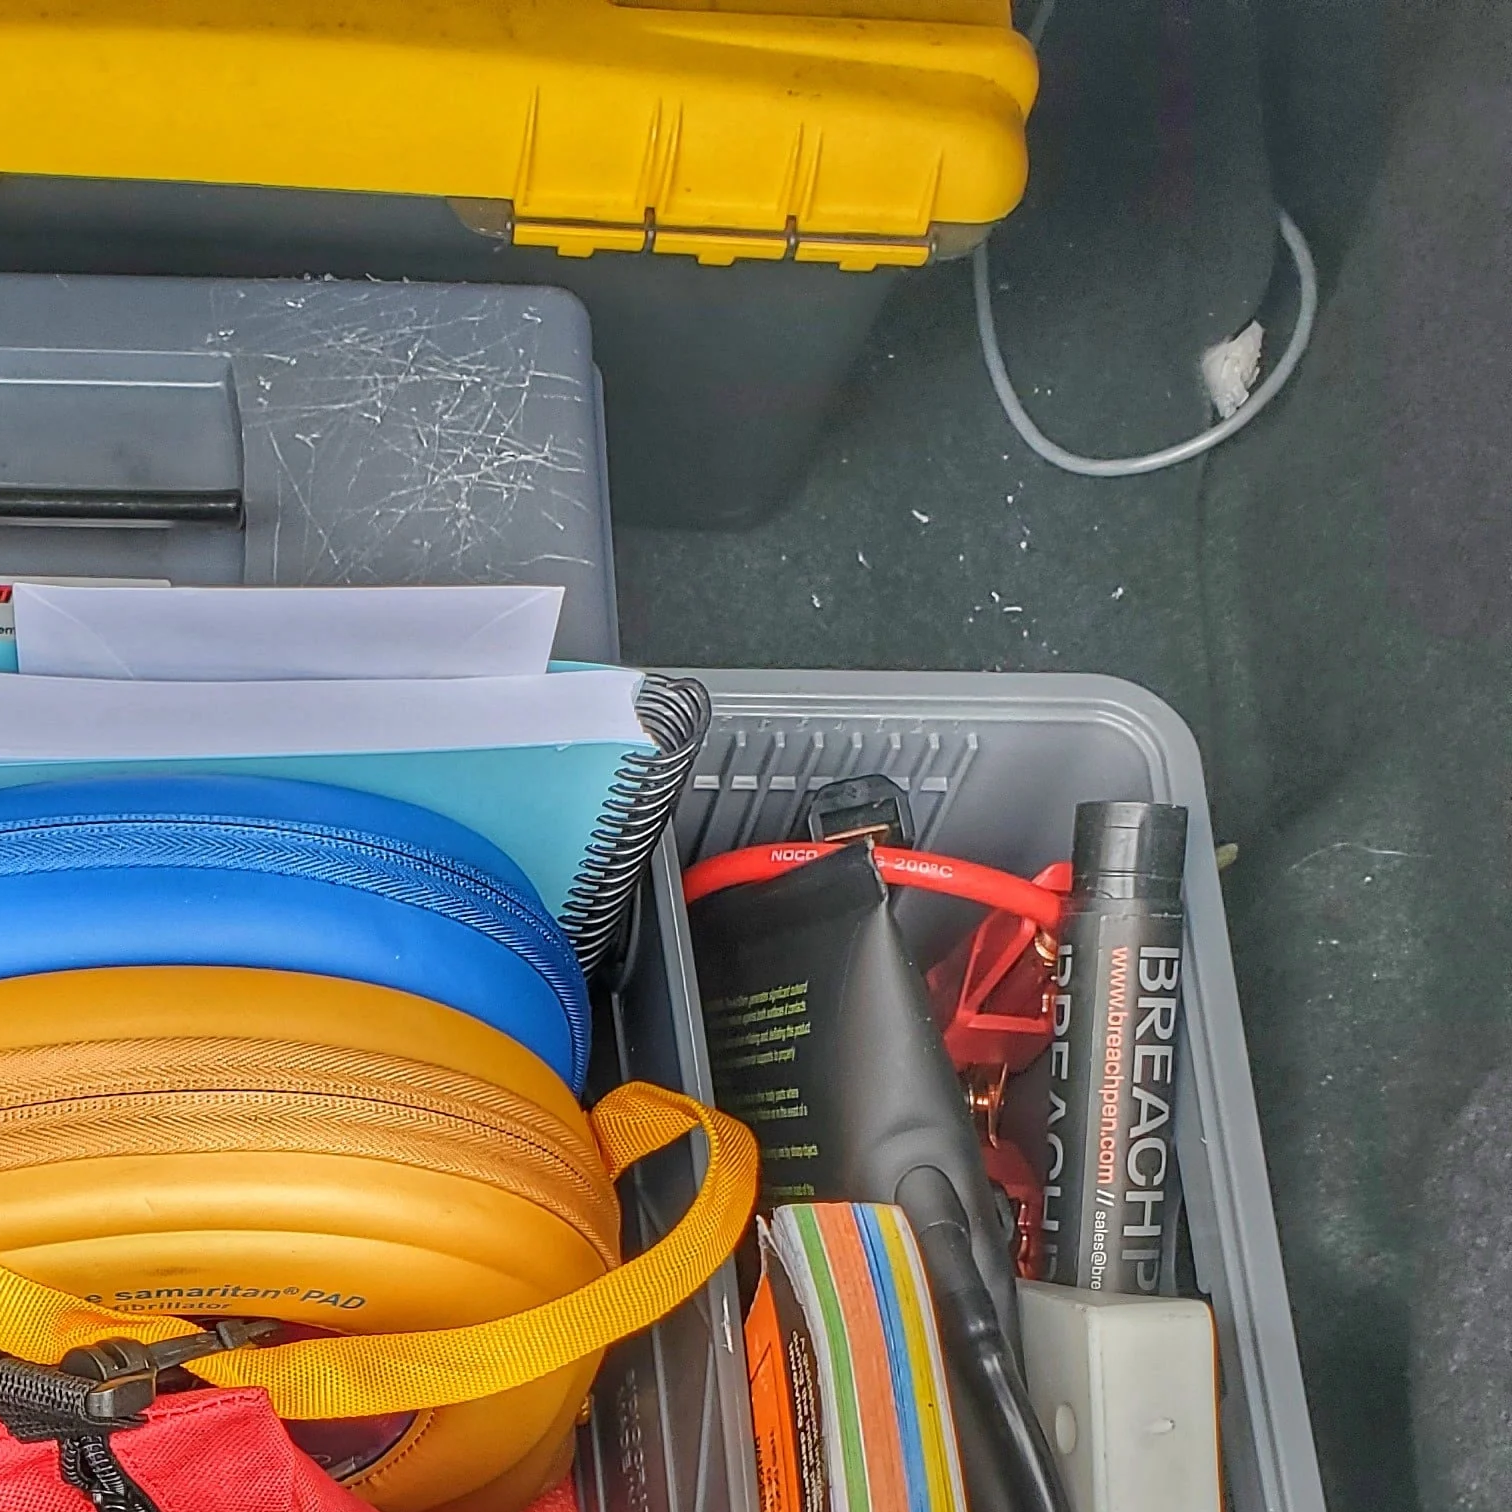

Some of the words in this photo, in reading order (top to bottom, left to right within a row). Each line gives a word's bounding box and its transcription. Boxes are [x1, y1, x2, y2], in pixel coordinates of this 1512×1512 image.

[771, 849, 818, 862] NOCO
[1097, 946, 1128, 1185] www.breachpen.com
[1121, 946, 1180, 1291] BREACHP
[1090, 1210, 1107, 1291] sales@bre
[300, 1289, 368, 1310] PAD
[789, 1341, 803, 1429] involving
[792, 1330, 804, 1386] during
[803, 1353, 818, 1444] guidebook
